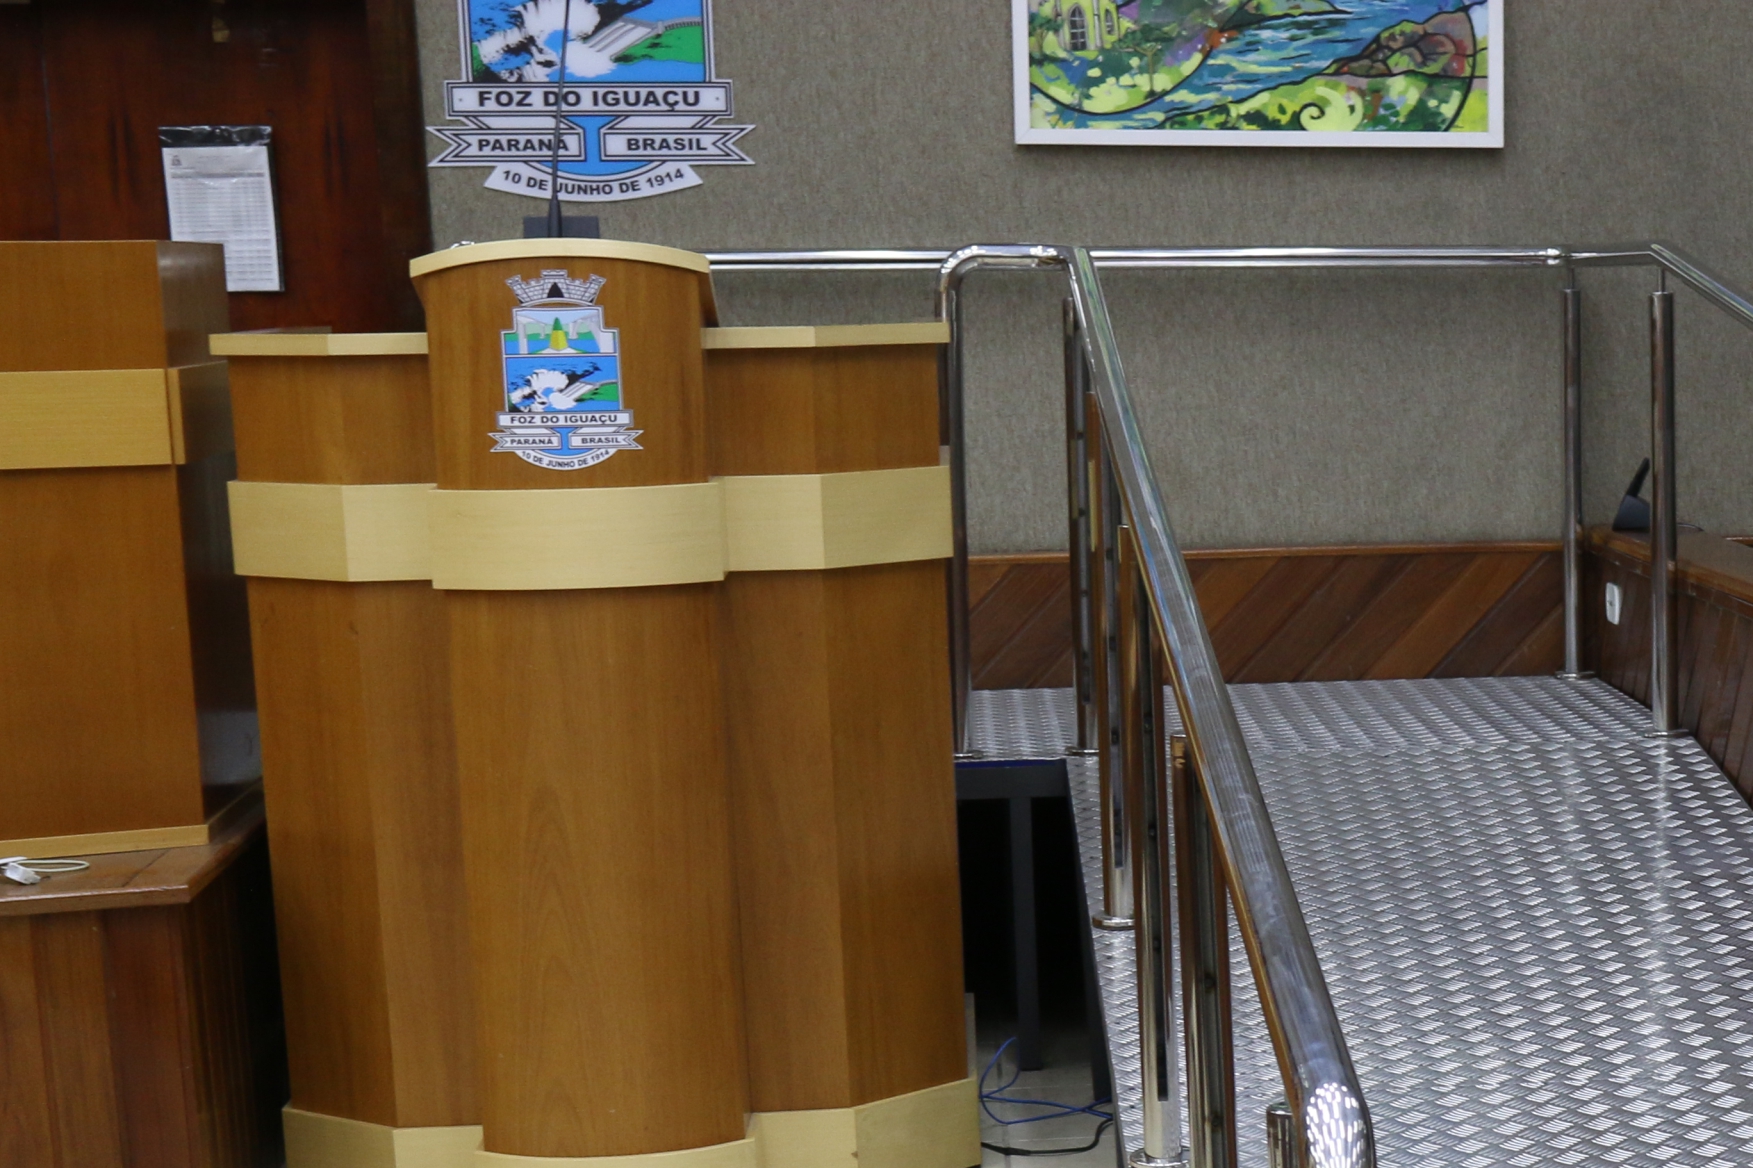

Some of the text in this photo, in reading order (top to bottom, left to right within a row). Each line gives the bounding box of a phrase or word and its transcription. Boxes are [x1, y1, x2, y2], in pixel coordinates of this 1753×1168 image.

[478, 89, 700, 112] FOZ DO IGUAÇU
[477, 134, 569, 153] PARANÁ
[626, 136, 708, 152] BRASIL
[503, 168, 685, 195] 10 DE JUNHO DE 1914
[510, 414, 618, 425] FOZ DO IGUAÇU
[510, 436, 554, 445] PARANÁ
[581, 436, 621, 444] BRASIL
[521, 449, 610, 468] 10 DE JUNHO DE 1914
